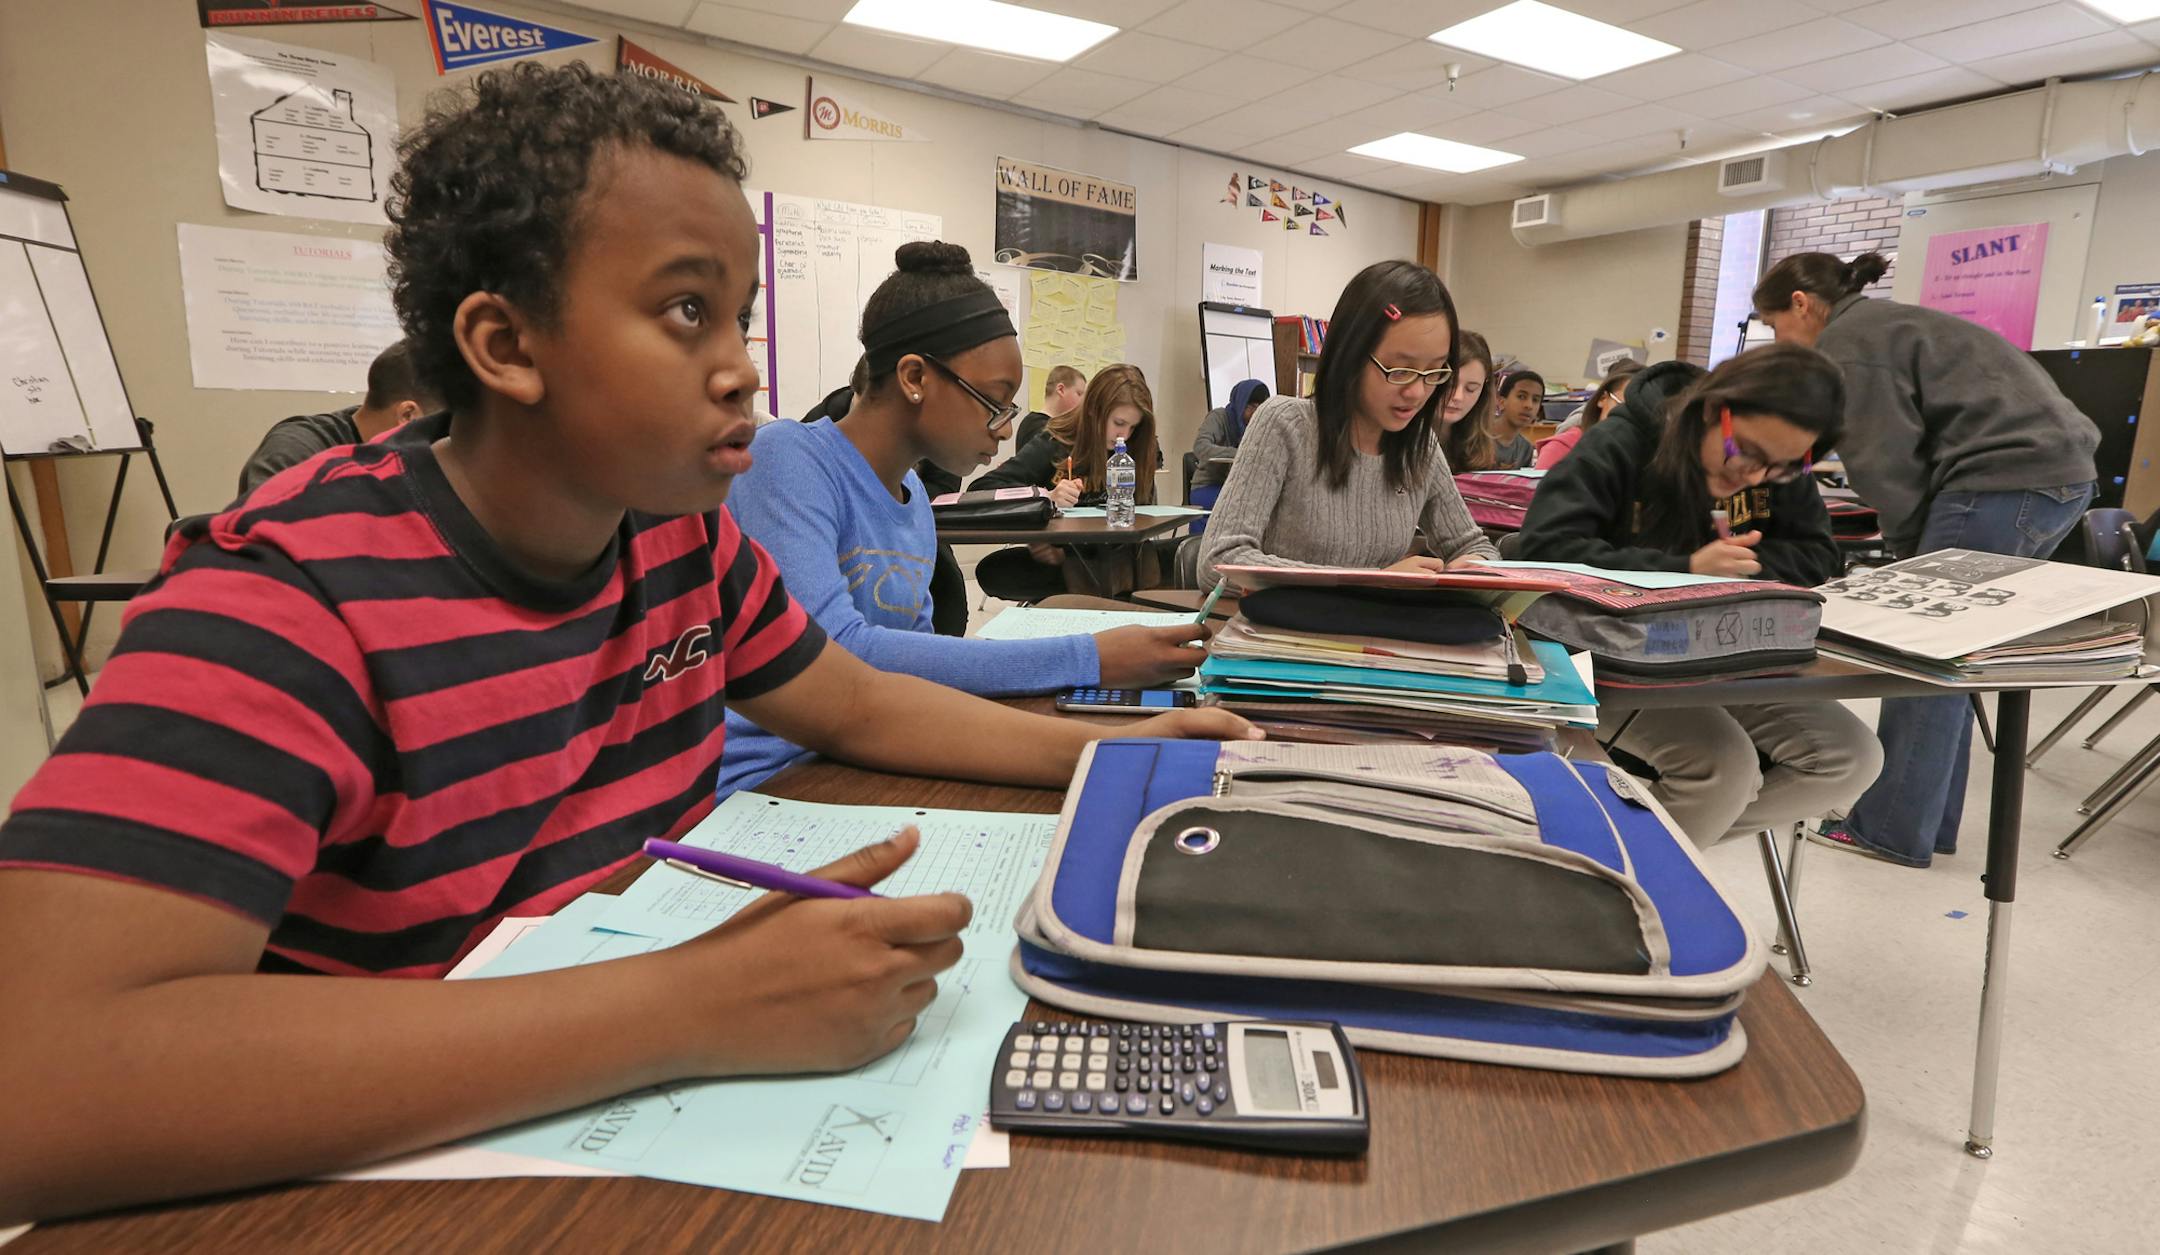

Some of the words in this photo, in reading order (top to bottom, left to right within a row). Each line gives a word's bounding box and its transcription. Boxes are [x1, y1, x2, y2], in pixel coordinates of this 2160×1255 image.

[439, 9, 546, 52] Everest
[627, 59, 703, 96] MORRIS
[843, 107, 903, 138] MORRIS
[999, 165, 1053, 194] WALL
[1058, 178, 1082, 198] OF
[1087, 183, 1134, 209] FAME
[293, 245, 352, 259] TUTORIALS
[1951, 234, 2021, 266] SLANT
[580, 1100, 638, 1153] AVID
[798, 1130, 849, 1188] AVID
